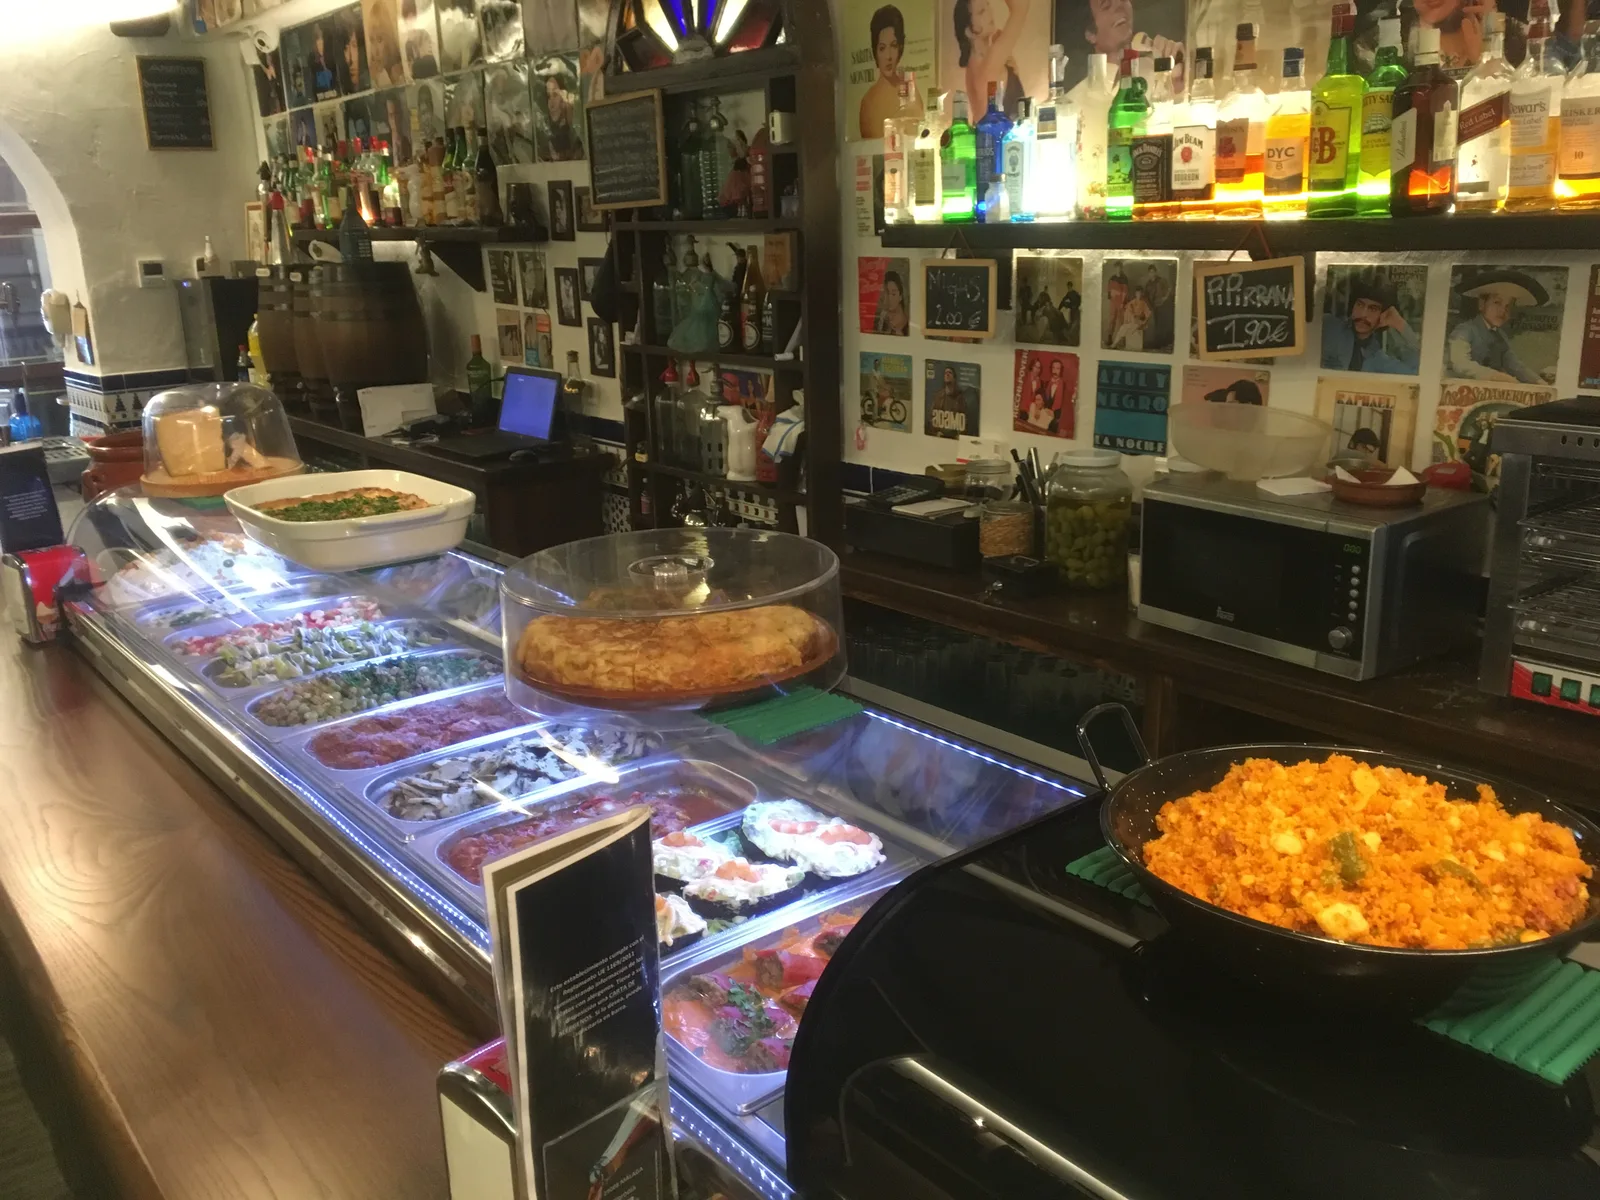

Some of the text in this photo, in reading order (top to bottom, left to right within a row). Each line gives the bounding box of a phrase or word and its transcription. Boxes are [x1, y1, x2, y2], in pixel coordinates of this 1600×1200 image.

[1460, 108, 1496, 131] Red Label
[1184, 133, 1204, 150] BEAM
[1267, 146, 1296, 159] DYC
[1100, 369, 1148, 388] AZUL
[1156, 372, 1169, 388] Y
[1097, 391, 1168, 412] NEGRO
[1095, 434, 1165, 453] LA NOCHE
[563, 958, 609, 986] establecimiento
[608, 984, 628, 999] CARTA
